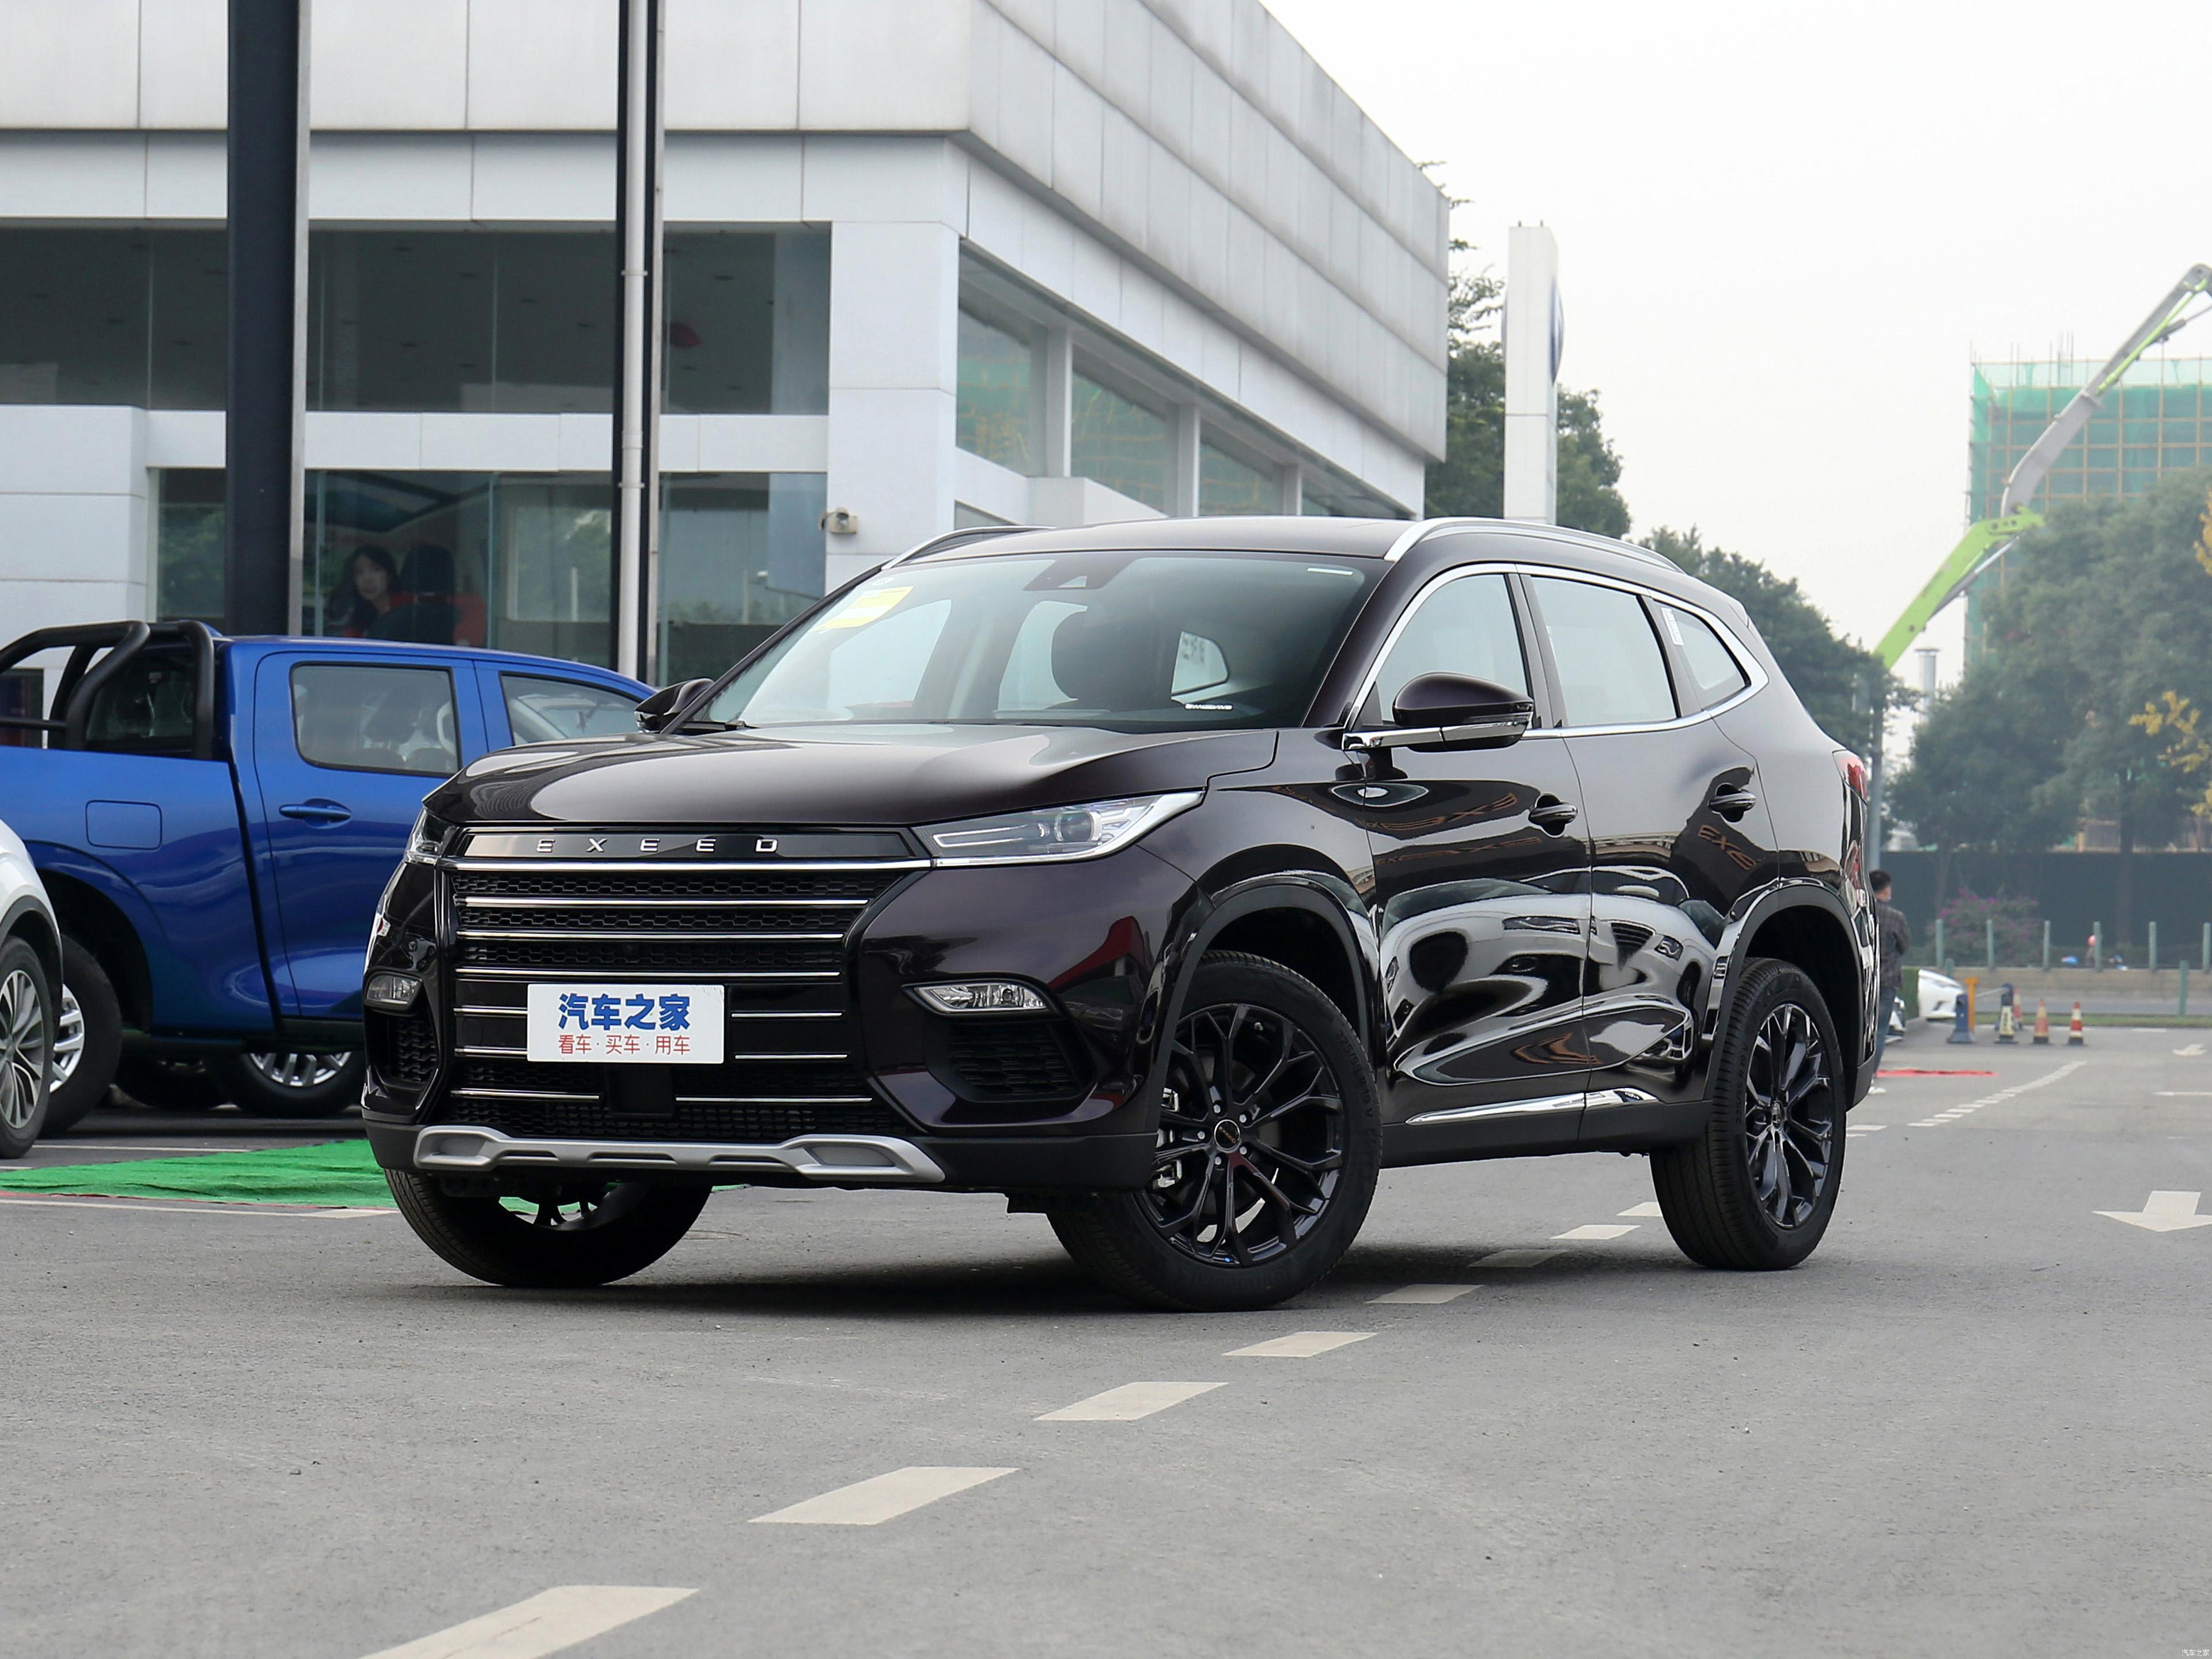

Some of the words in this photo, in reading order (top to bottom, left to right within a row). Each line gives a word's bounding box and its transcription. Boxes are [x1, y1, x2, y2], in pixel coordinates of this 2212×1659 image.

[536, 838, 778, 853] EXEED
[558, 993, 691, 1031] 汽车之家
